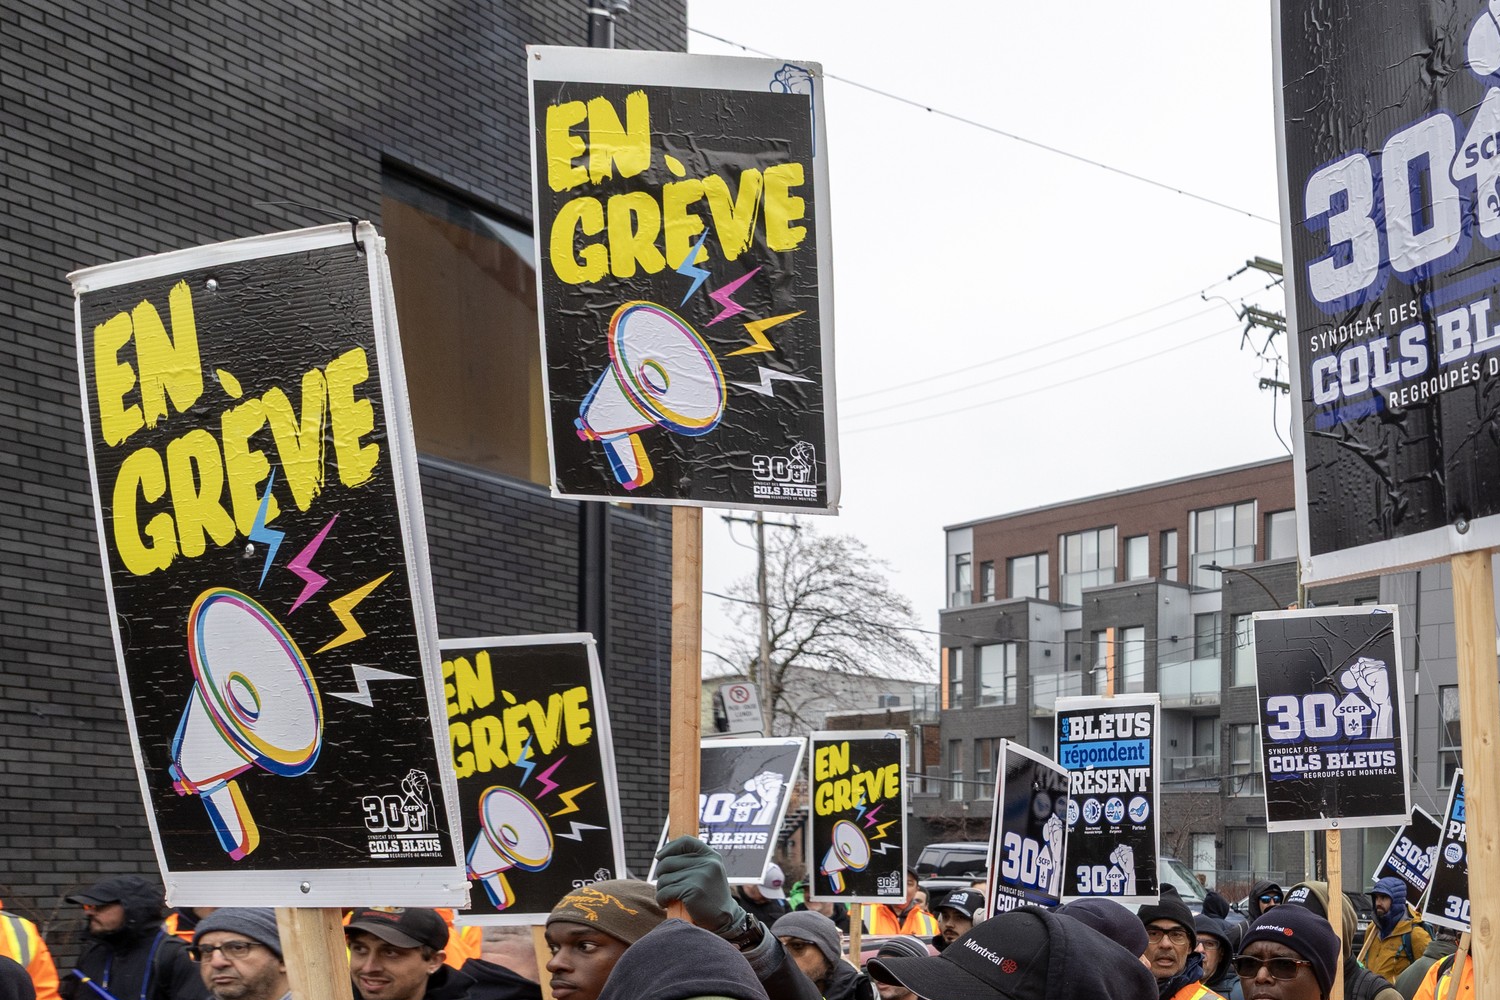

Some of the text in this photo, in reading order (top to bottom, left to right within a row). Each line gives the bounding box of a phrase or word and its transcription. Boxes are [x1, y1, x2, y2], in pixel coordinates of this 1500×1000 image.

[547, 89, 650, 192] EN
[550, 153, 806, 286] GRÈVE
[1310, 300, 1418, 353] SYNDICAT DES
[93, 280, 204, 447] EN
[1312, 322, 1428, 407] COLS
[1388, 363, 1480, 410] REGROUPÉS
[113, 346, 381, 576] GRÈVE
[753, 485, 818, 498] COLS BLEUS
[441, 650, 495, 719] EN
[1339, 705, 1366, 714] SCFP
[449, 686, 593, 780] GRÈVE
[1060, 717, 1069, 742] Les
[1068, 711, 1151, 742] BLEUS
[815, 741, 850, 782] EN
[1064, 742, 1145, 768] répondent
[1268, 745, 1318, 755] SYNDICAT DES
[1269, 750, 1396, 773] COLS BLEUS
[1303, 766, 1397, 779] REGROUPÉS DE MONTRÉAL
[815, 763, 899, 817] GRÈVE
[369, 839, 441, 853] COLS BLEUS
[709, 832, 769, 845] BLEUS
[1038, 856, 1051, 866] SCFP
[1387, 855, 1406, 873] COLS
[1404, 868, 1427, 890] BLEUS
[998, 885, 1025, 897] SYNDICAT DES
[1256, 924, 1285, 932] Montréal
[963, 937, 1005, 966] Montréal
